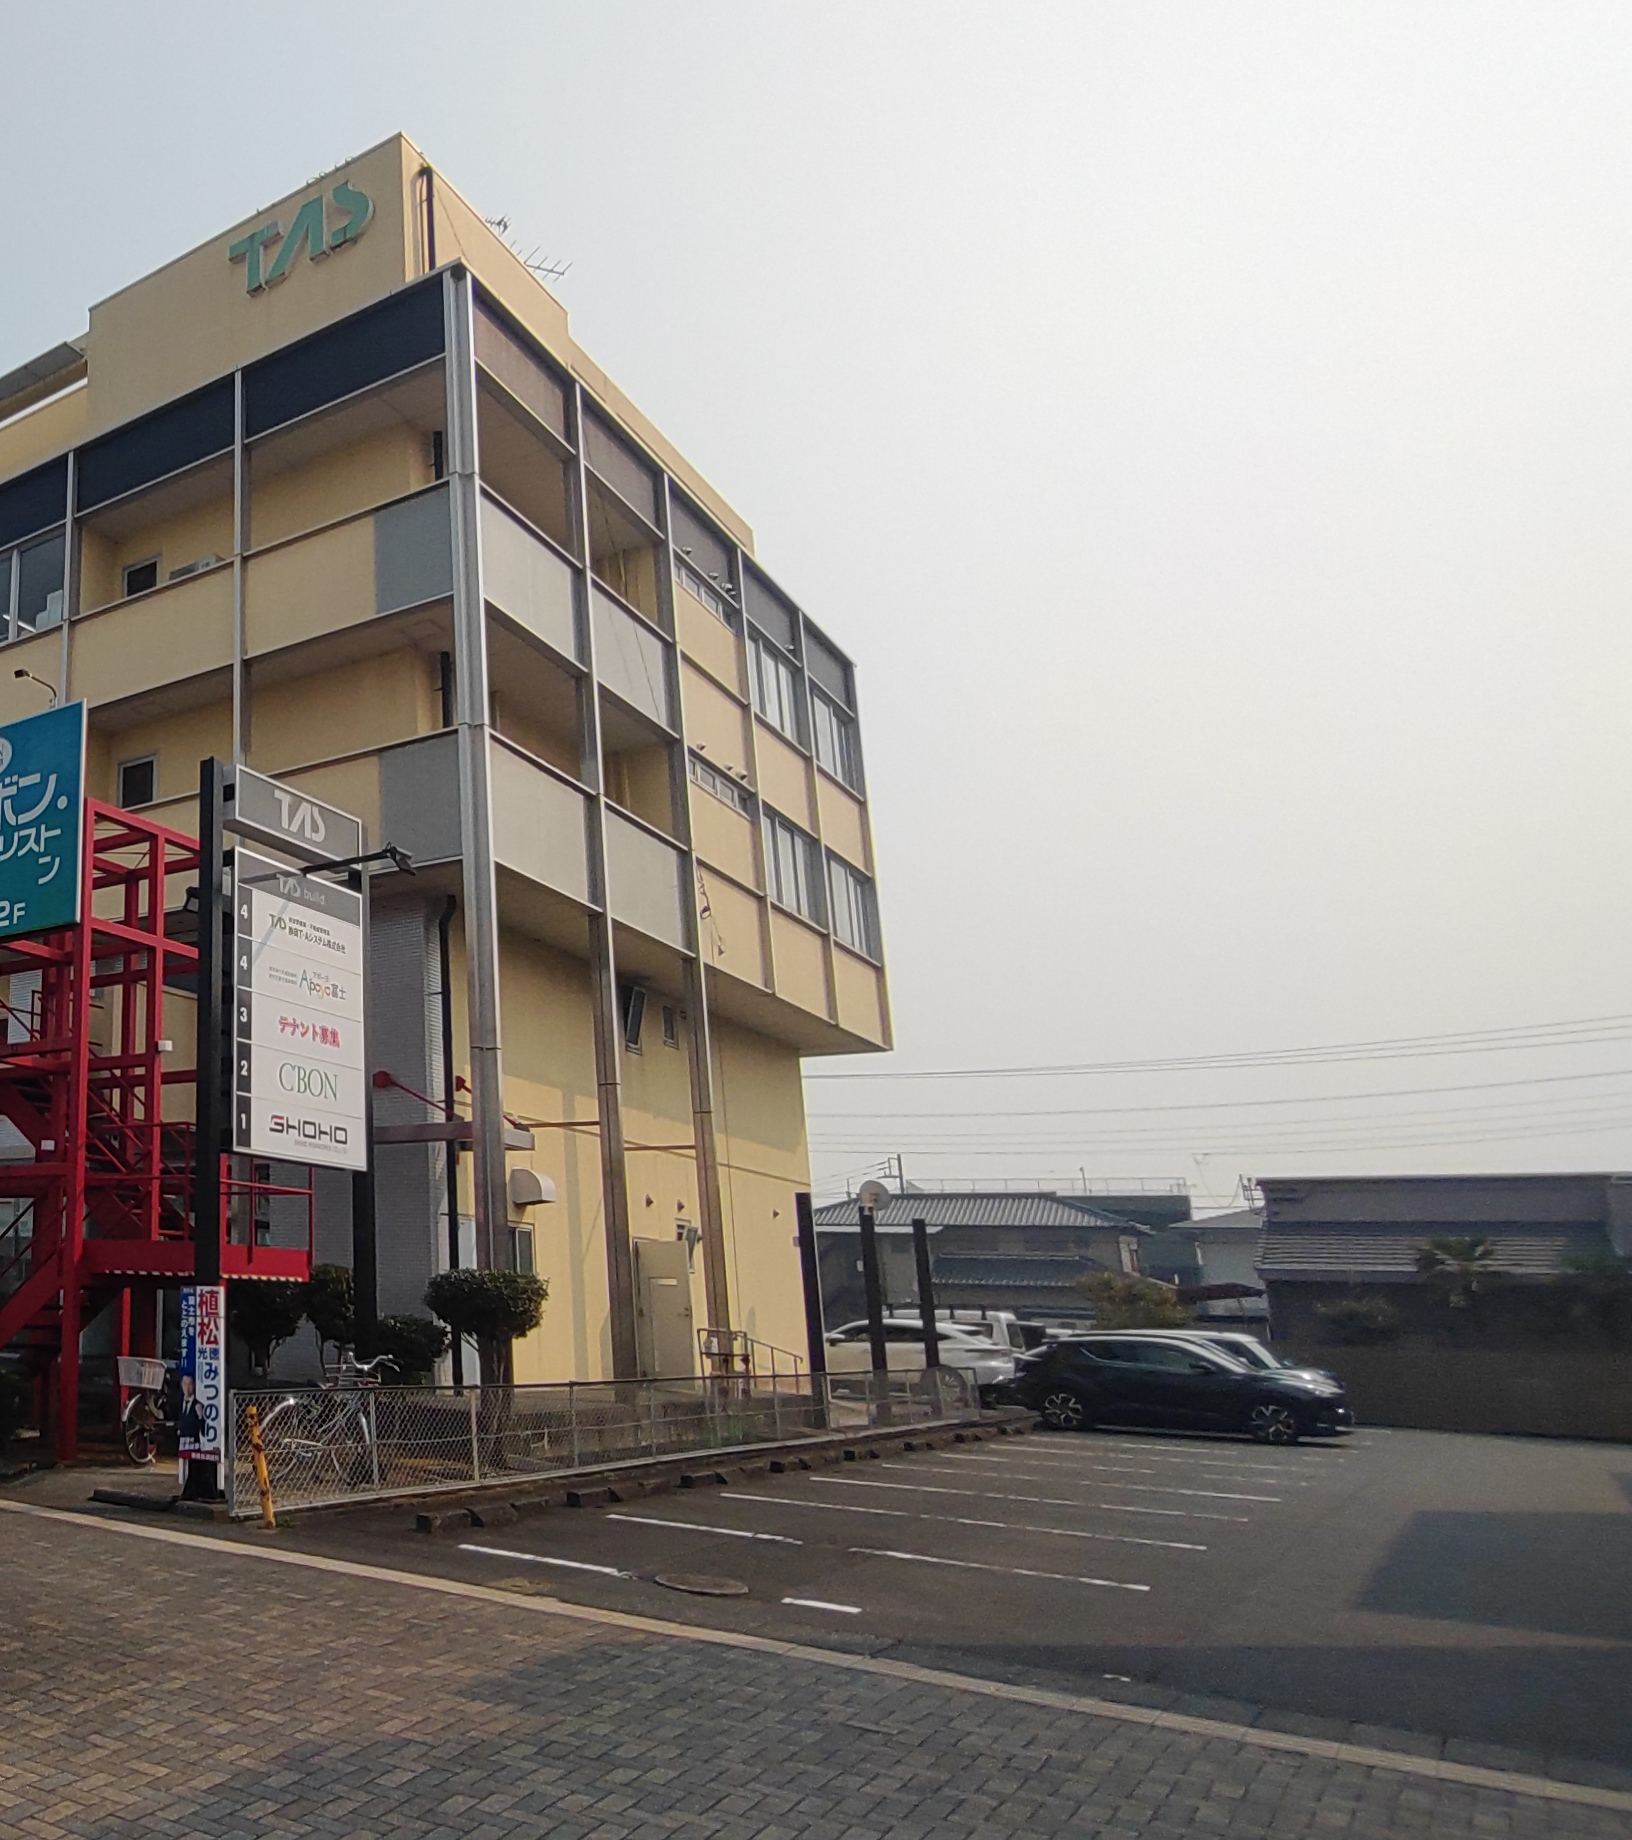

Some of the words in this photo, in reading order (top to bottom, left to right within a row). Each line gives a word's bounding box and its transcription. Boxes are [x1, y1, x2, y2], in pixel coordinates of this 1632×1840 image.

[228, 180, 372, 292] TAS
[274, 789, 326, 843] TAS
[240, 904, 249, 920] 4
[240, 955, 248, 970] 4
[240, 1007, 248, 1022] 3
[278, 1016, 341, 1049] テナント募集
[240, 1060, 248, 1076] 2
[279, 1062, 338, 1101] CBON
[240, 1113, 247, 1129] 1
[269, 1114, 348, 1145] SHOHO
[198, 1289, 219, 1346] 植松
[203, 1362, 218, 1443] みつのり
